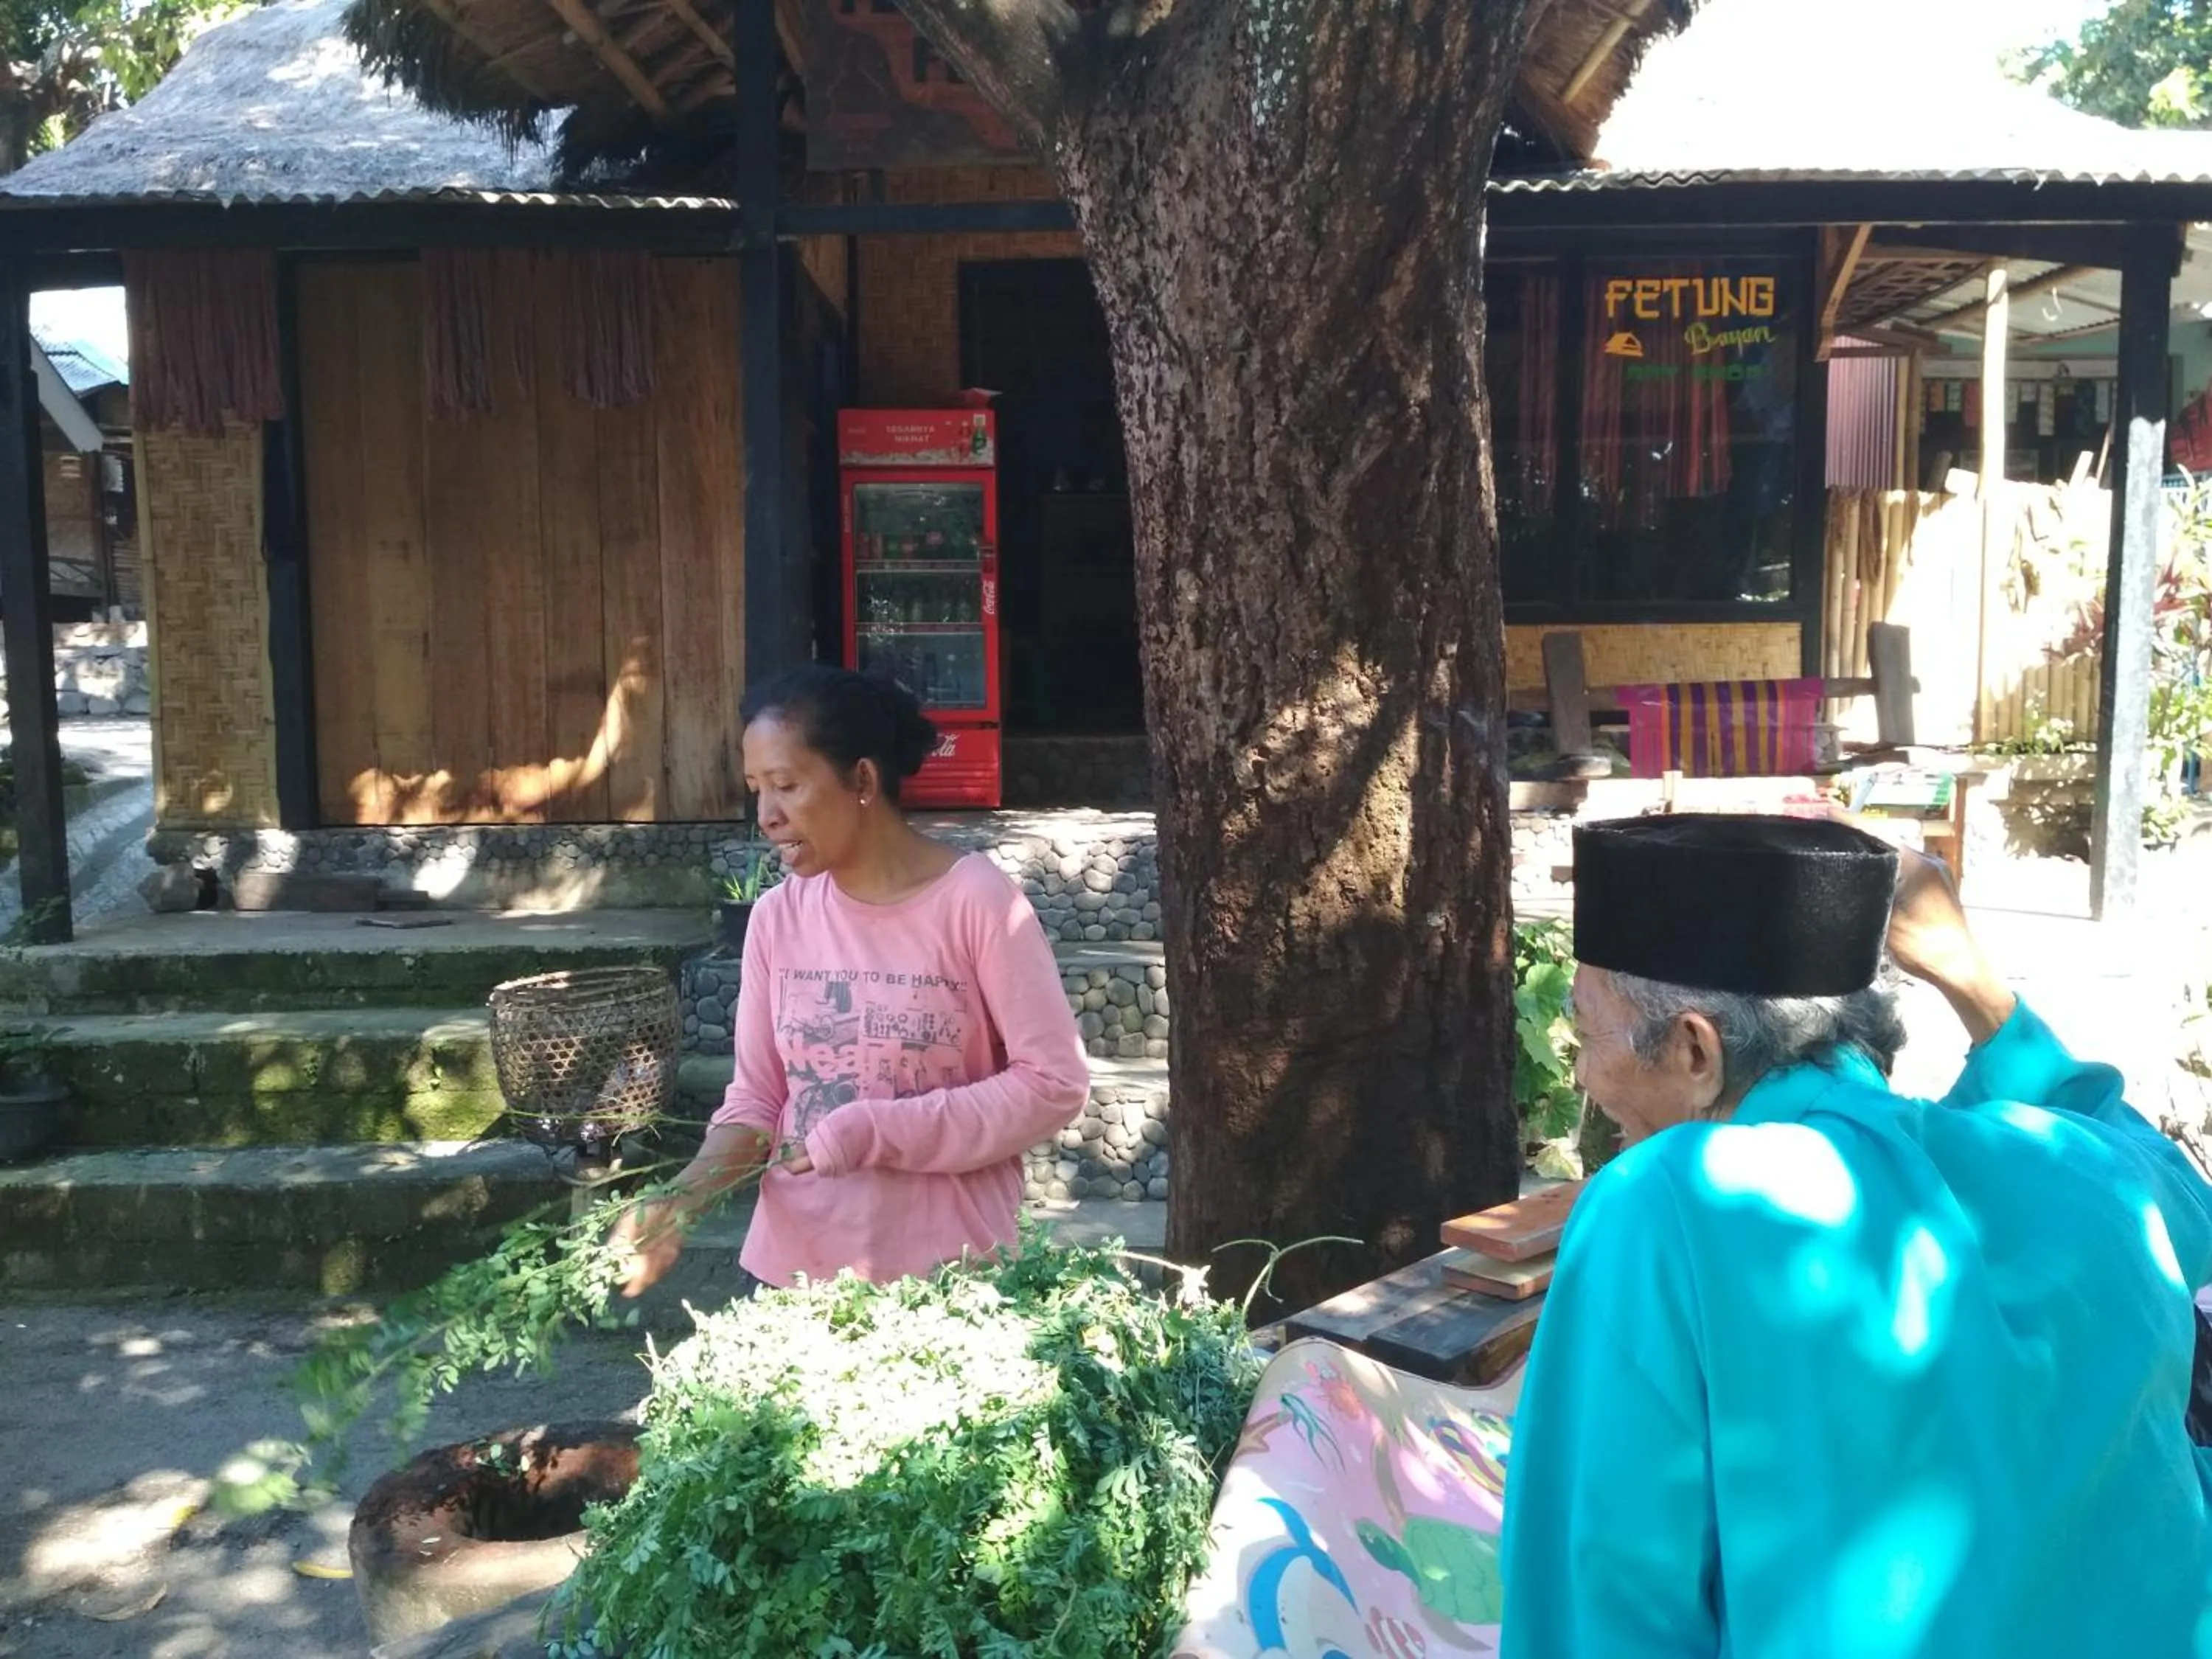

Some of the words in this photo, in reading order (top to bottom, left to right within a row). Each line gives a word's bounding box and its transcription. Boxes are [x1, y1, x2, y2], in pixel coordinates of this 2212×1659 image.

[1604, 276, 1775, 319] FETUNG
[793, 968, 832, 981] WANT
[836, 969, 859, 981] YOU
[862, 970, 880, 985] TO
[886, 973, 907, 986] BE
